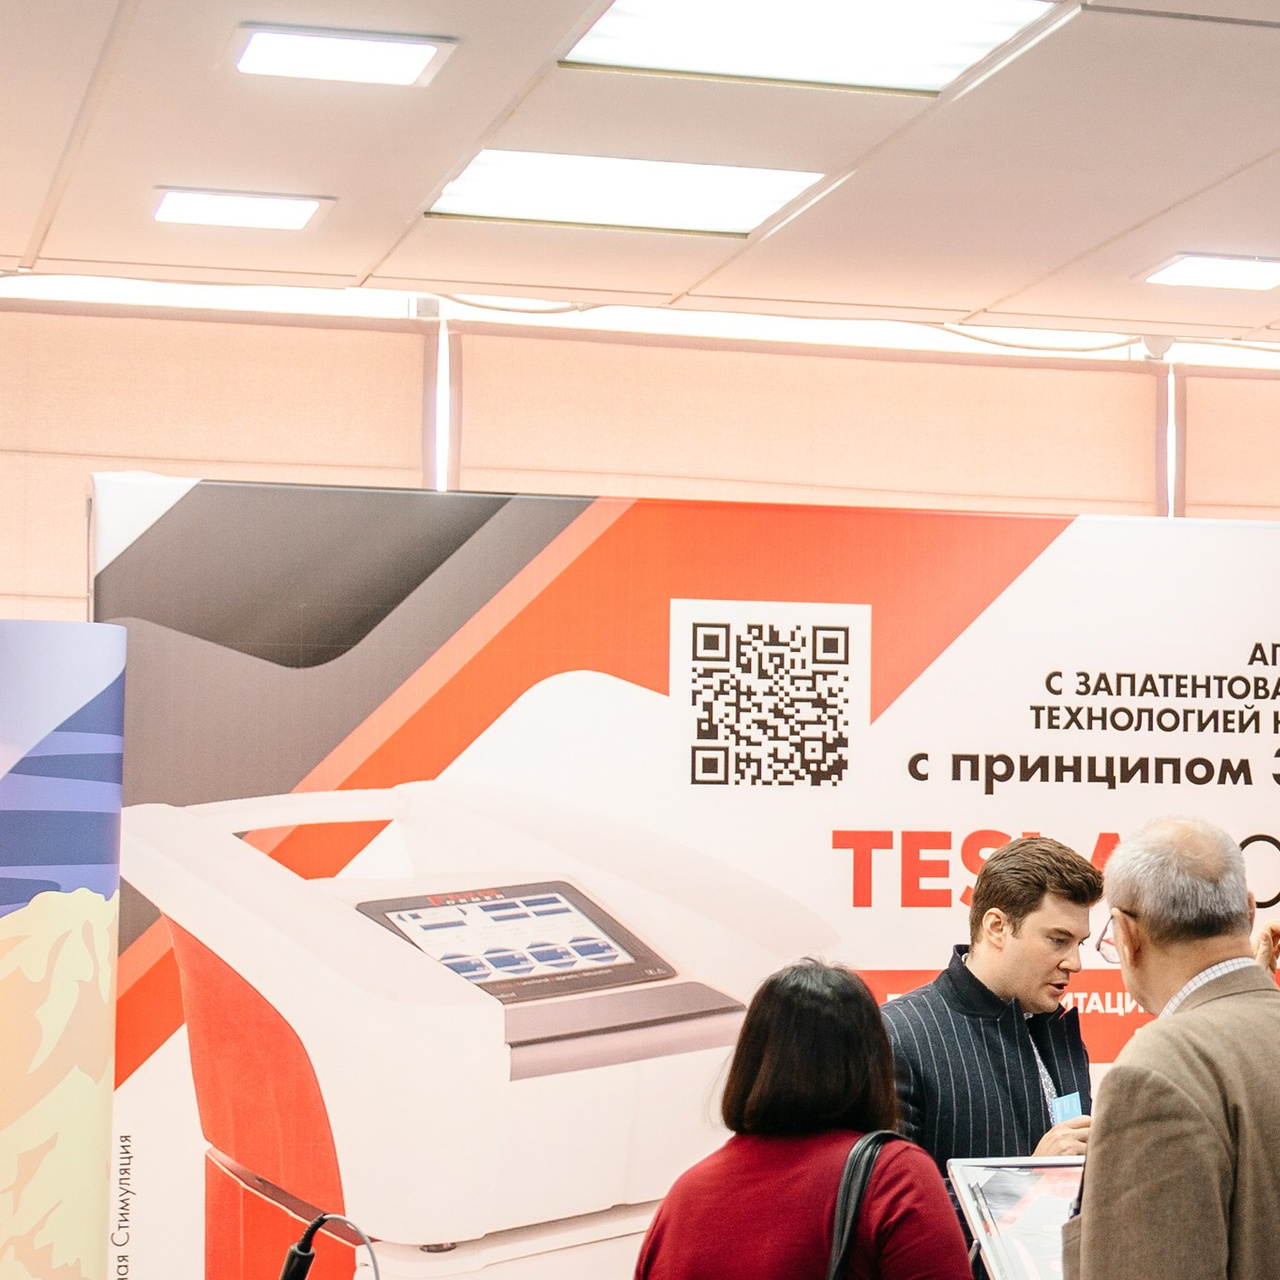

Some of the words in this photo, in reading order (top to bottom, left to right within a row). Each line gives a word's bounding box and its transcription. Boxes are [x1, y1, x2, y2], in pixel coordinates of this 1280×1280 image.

[1045, 671, 1063, 696] С
[1029, 704, 1260, 734] ТЕХНОЛОГИЕЙ
[907, 752, 929, 782] с
[951, 753, 1253, 796] принципом
[110, 1134, 136, 1248] Стимуляция
